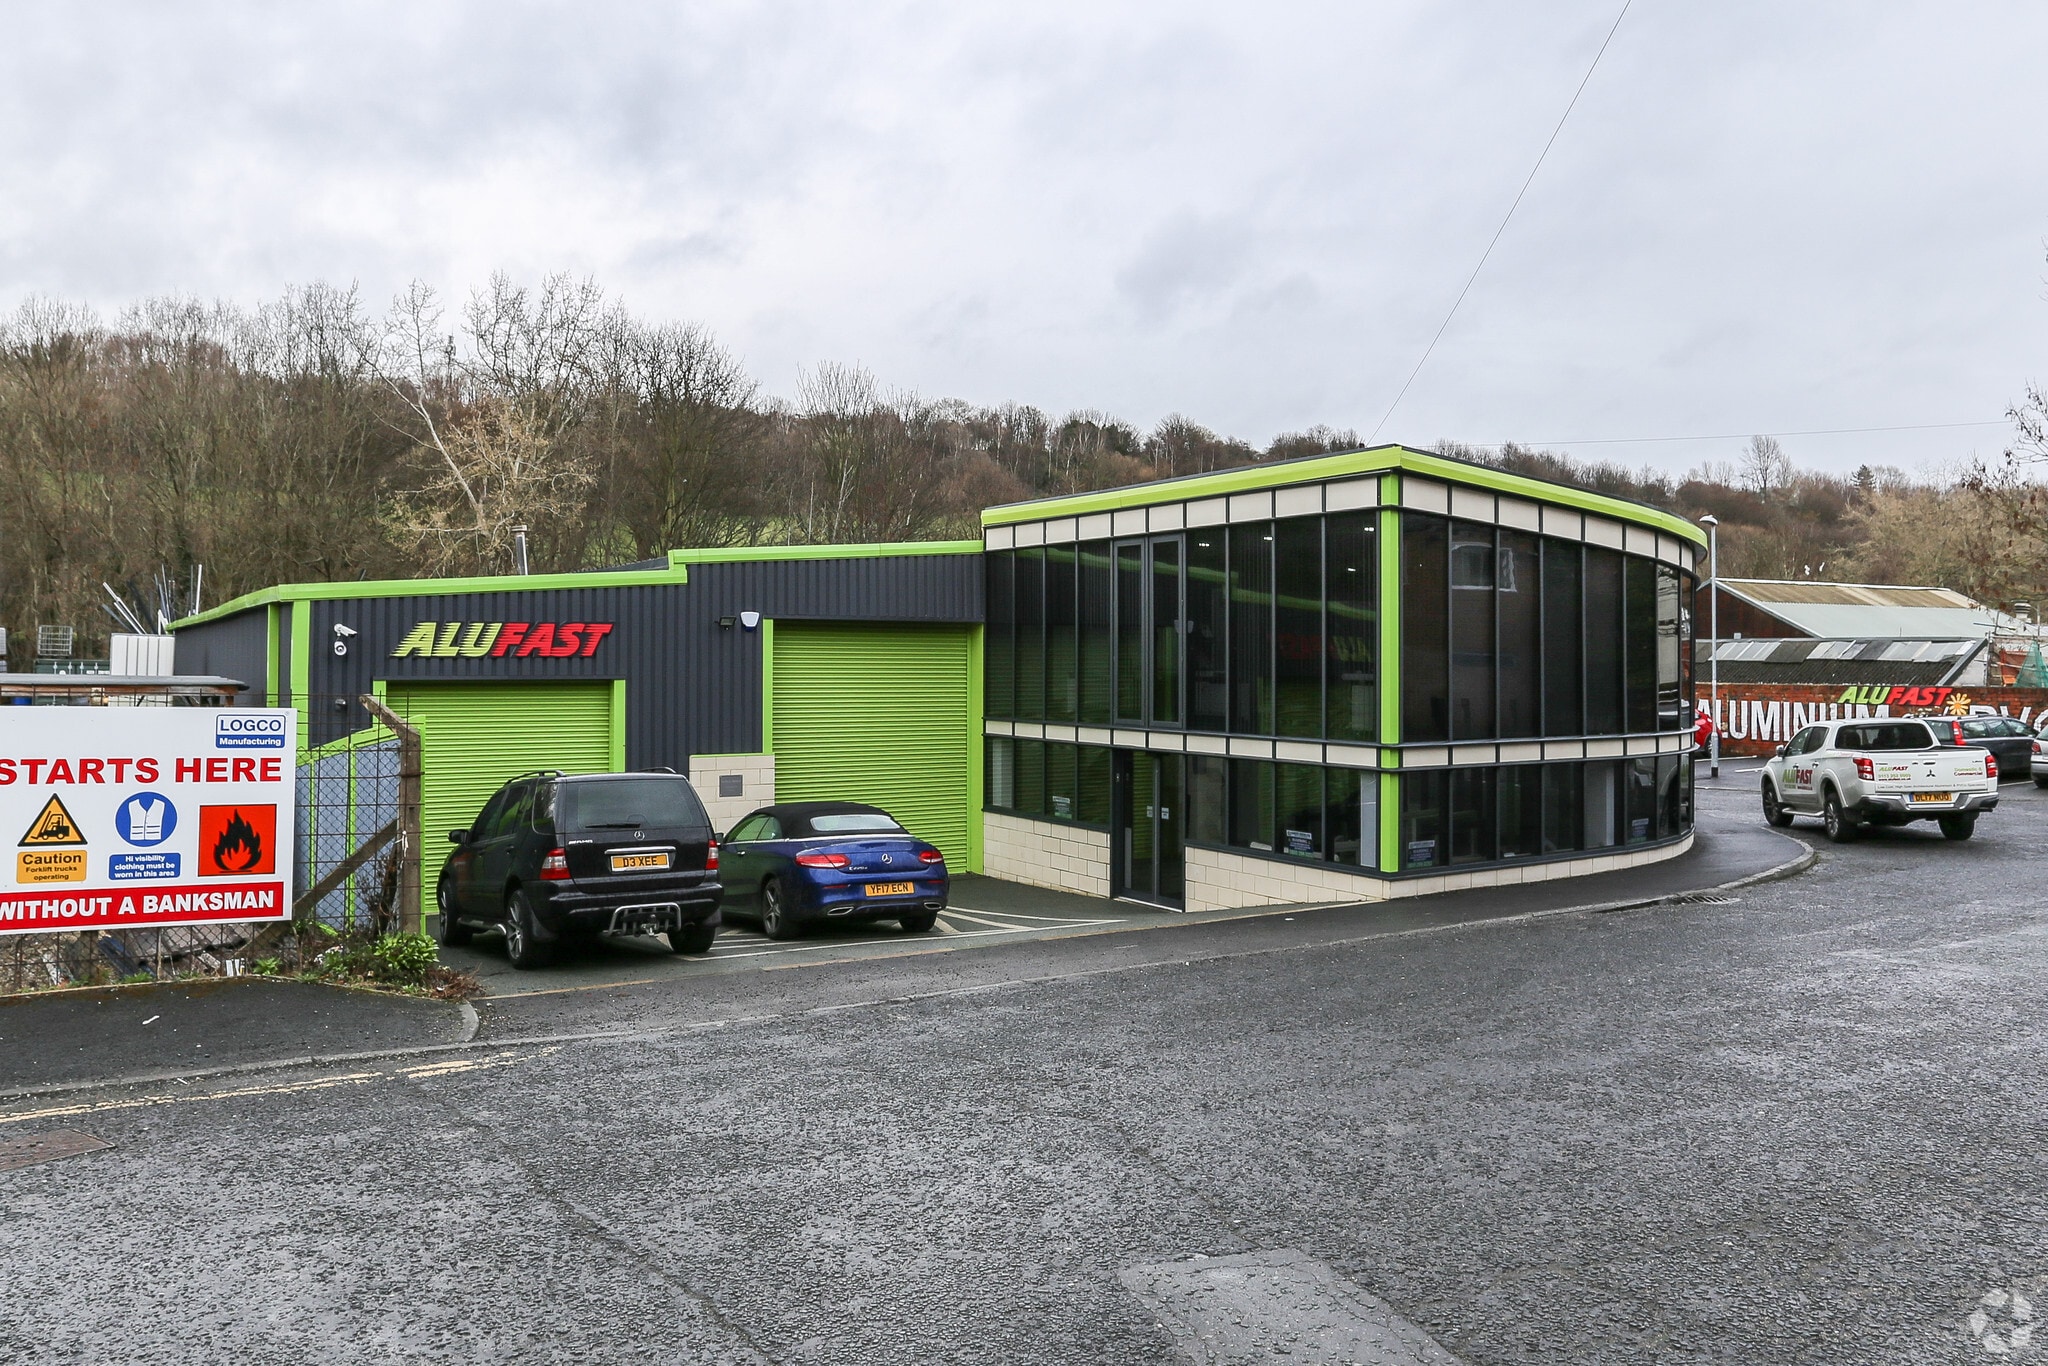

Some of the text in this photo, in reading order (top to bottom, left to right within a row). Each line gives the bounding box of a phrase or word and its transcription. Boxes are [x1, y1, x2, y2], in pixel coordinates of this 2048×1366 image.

[389, 621, 614, 657] ALUFAST
[1837, 686, 1953, 706] ALUFAST
[220, 719, 282, 732] LOGCO
[219, 737, 282, 748] Manufacturing
[0, 757, 282, 786] STARTS HERE
[22, 853, 82, 865] Caution
[125, 854, 166, 864] Hi visibility
[623, 855, 658, 867] D3 XEE
[25, 865, 53, 873] Forklift
[114, 861, 175, 872] clothing must be
[33, 873, 69, 882] operating
[114, 870, 175, 879] worn in this area
[870, 883, 909, 894] YF17 ECN
[0, 890, 274, 922] WITHOUT A BANKSMAN
